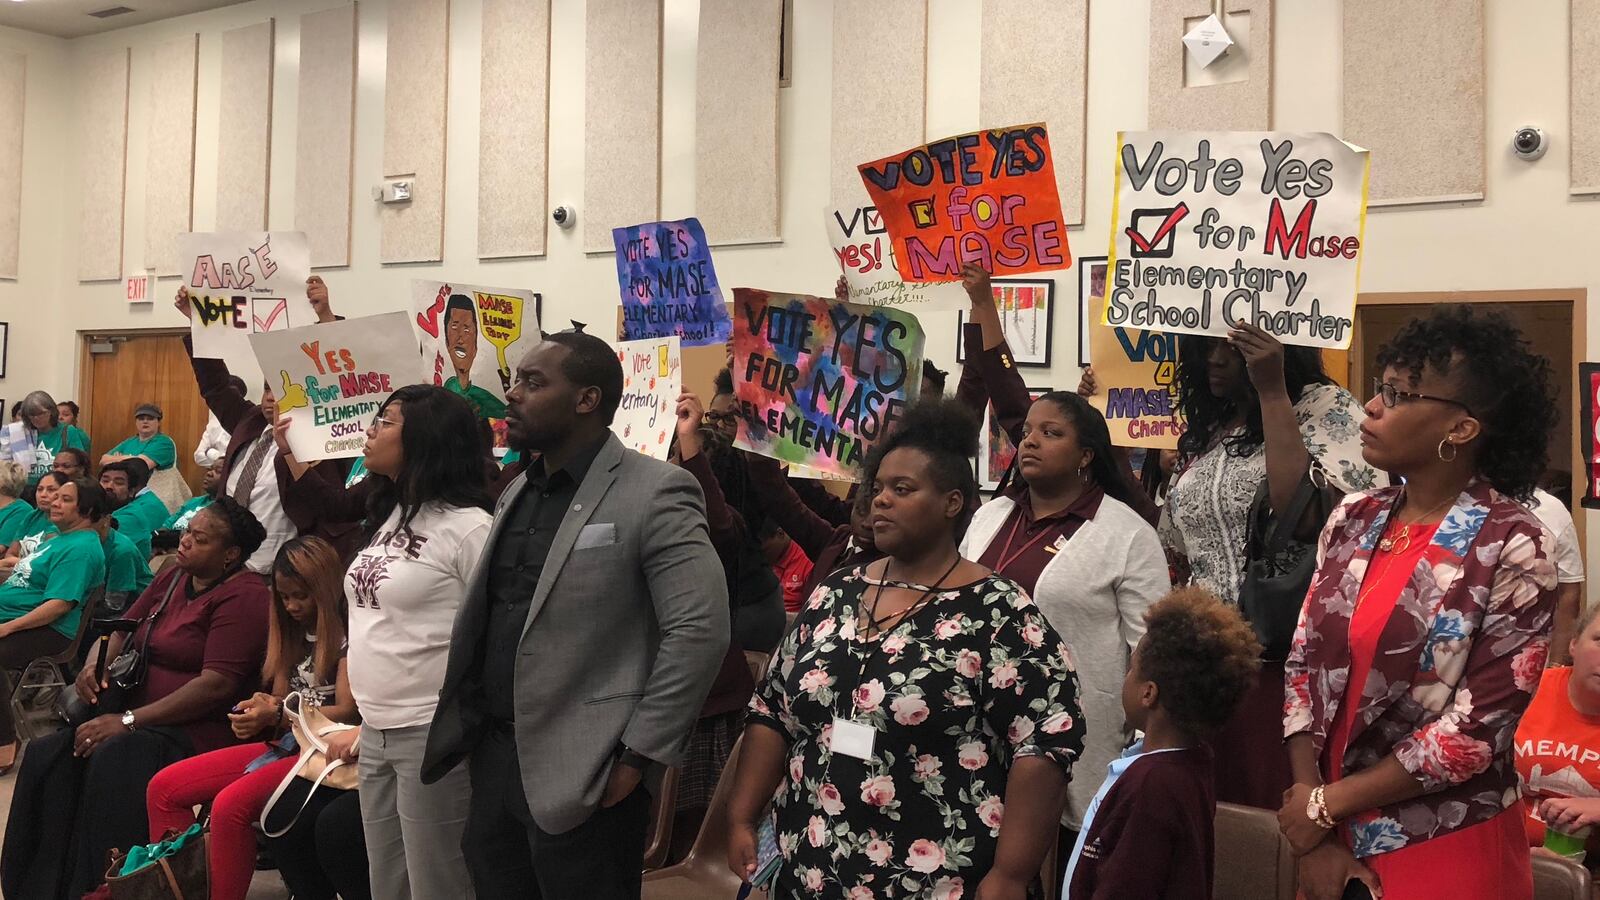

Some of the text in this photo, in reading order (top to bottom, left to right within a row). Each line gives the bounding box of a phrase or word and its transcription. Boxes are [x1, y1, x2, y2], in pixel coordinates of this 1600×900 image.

[863, 126, 1046, 192] VOTE YES
[1121, 138, 1334, 201] Vote Yes
[947, 185, 1026, 231] for
[1193, 198, 1361, 260] for Mase
[622, 227, 689, 263] VOTE YES
[904, 221, 1064, 279] MASE
[128, 278, 147, 299] EXIT
[657, 260, 711, 299] MASE
[1114, 258, 1308, 307] Elementary
[623, 302, 700, 324] ELEMENTARY
[1107, 286, 1353, 342] School Charter
[300, 340, 356, 375] YES
[744, 302, 907, 394] VOTE YES
[305, 371, 394, 404] for MASE
[746, 352, 802, 407] FOR
[741, 400, 868, 466] ELEMENTA
[1514, 739, 1600, 769] MEMP
